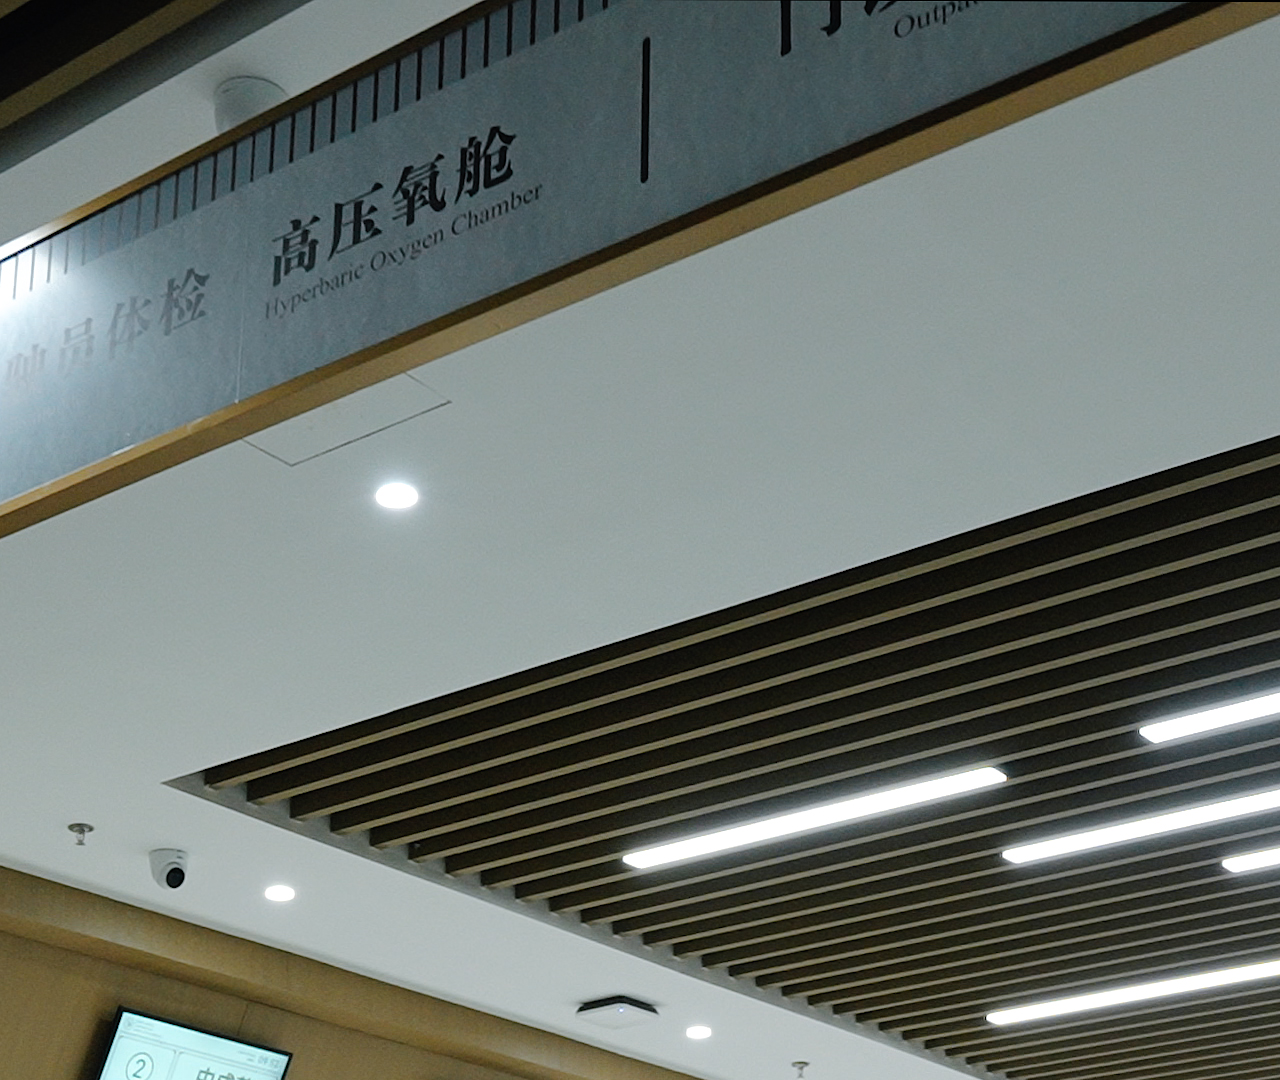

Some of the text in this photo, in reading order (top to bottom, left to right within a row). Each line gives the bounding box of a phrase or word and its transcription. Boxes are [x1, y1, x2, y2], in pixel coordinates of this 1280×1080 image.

[264, 184, 543, 319] Hyperbaric Oxygen Chamber
[272, 125, 516, 287] 高压氧舱
